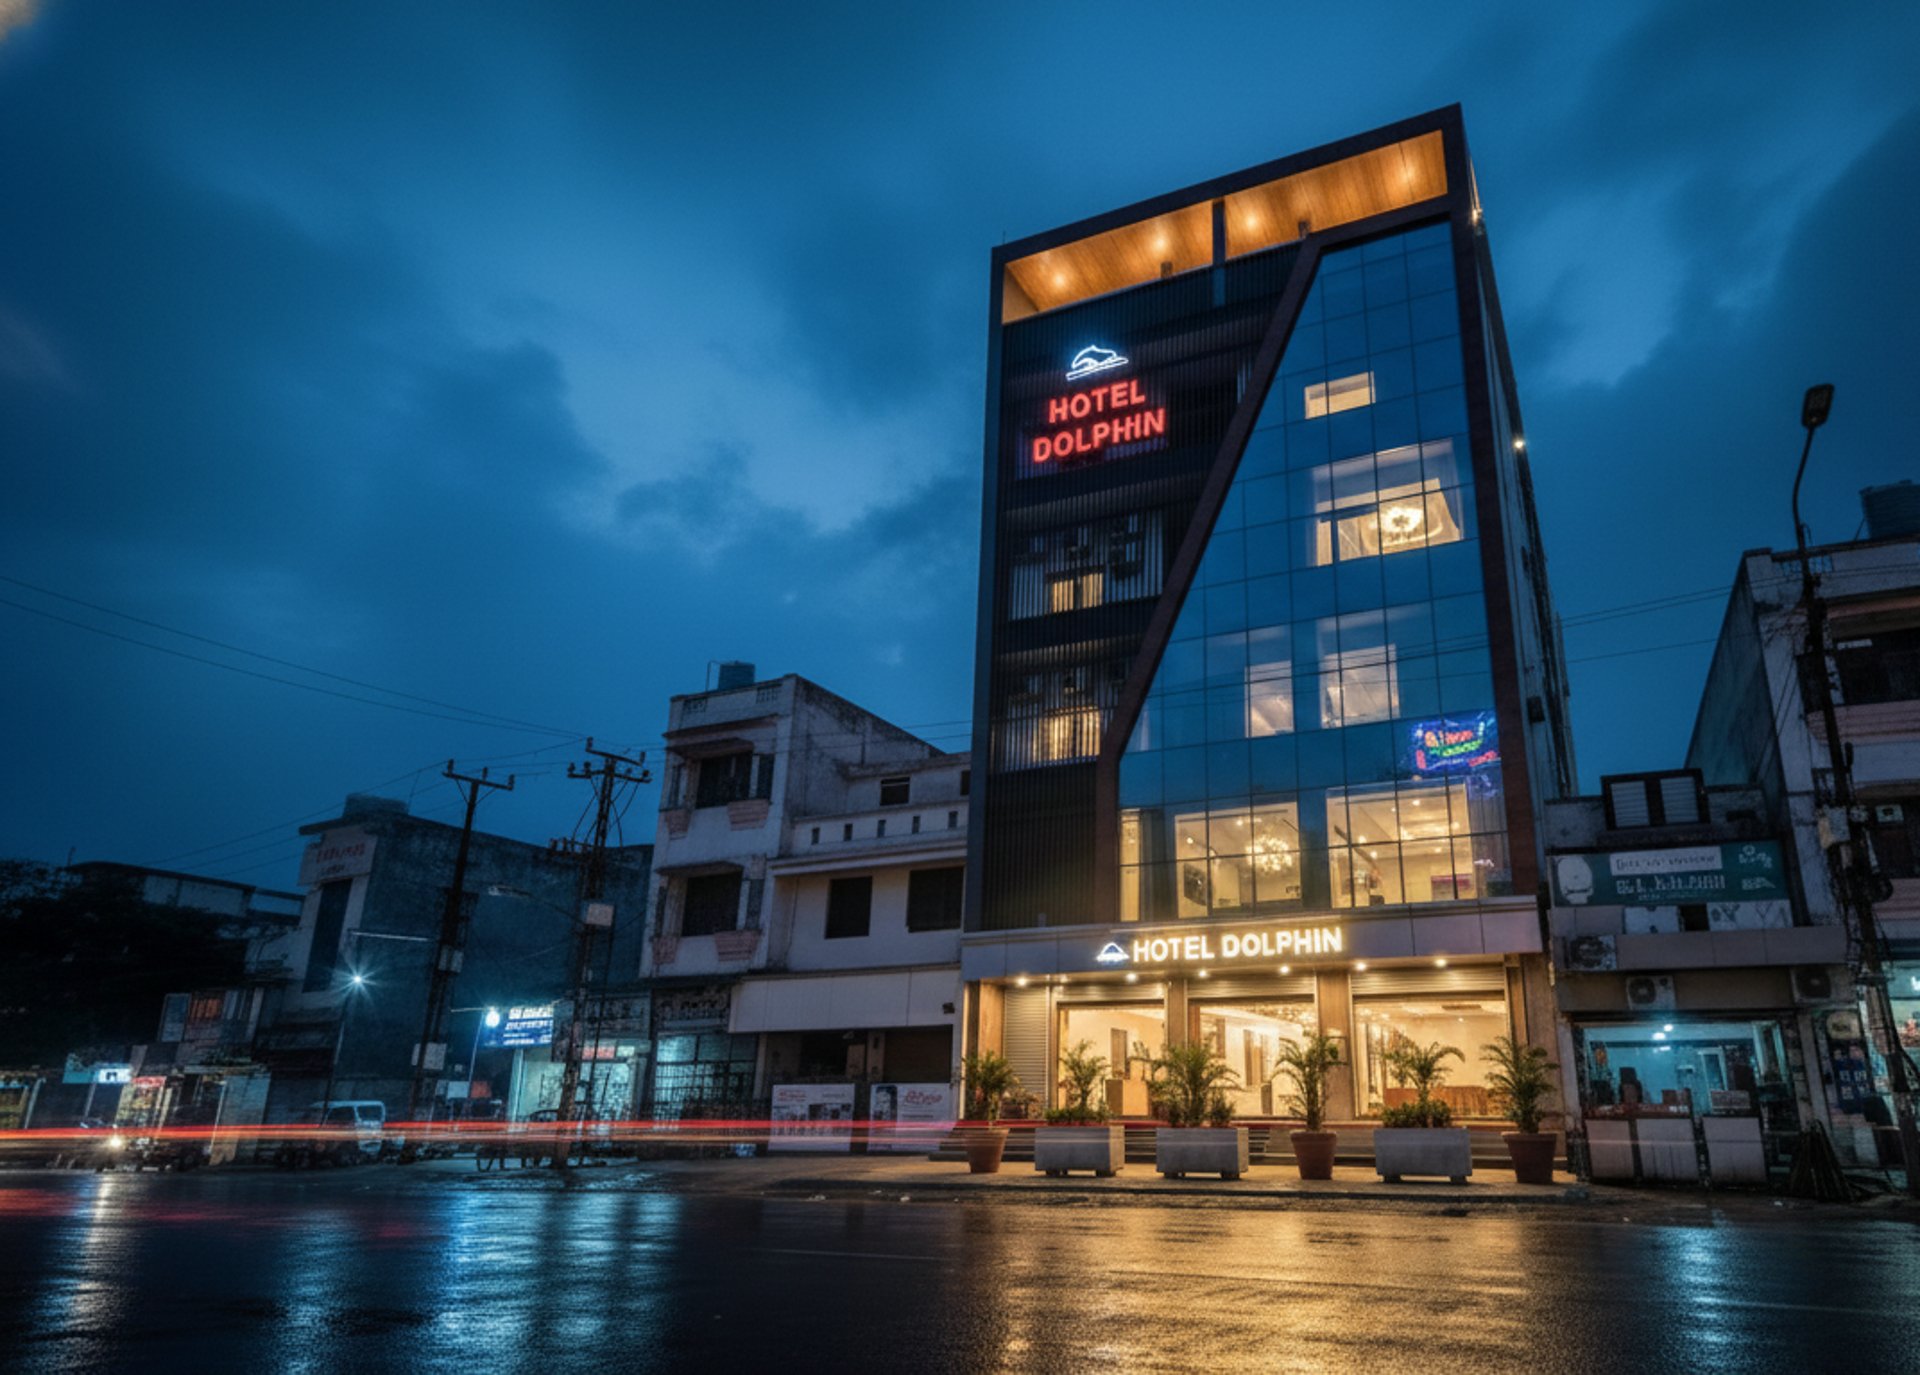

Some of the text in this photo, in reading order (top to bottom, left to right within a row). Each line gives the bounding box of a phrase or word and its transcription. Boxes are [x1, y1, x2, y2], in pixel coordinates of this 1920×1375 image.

[1049, 380, 1146, 423] HOTEL
[1032, 408, 1166, 464] DOLPHIN
[1133, 927, 1343, 963] HOTEL DOLPHIN
